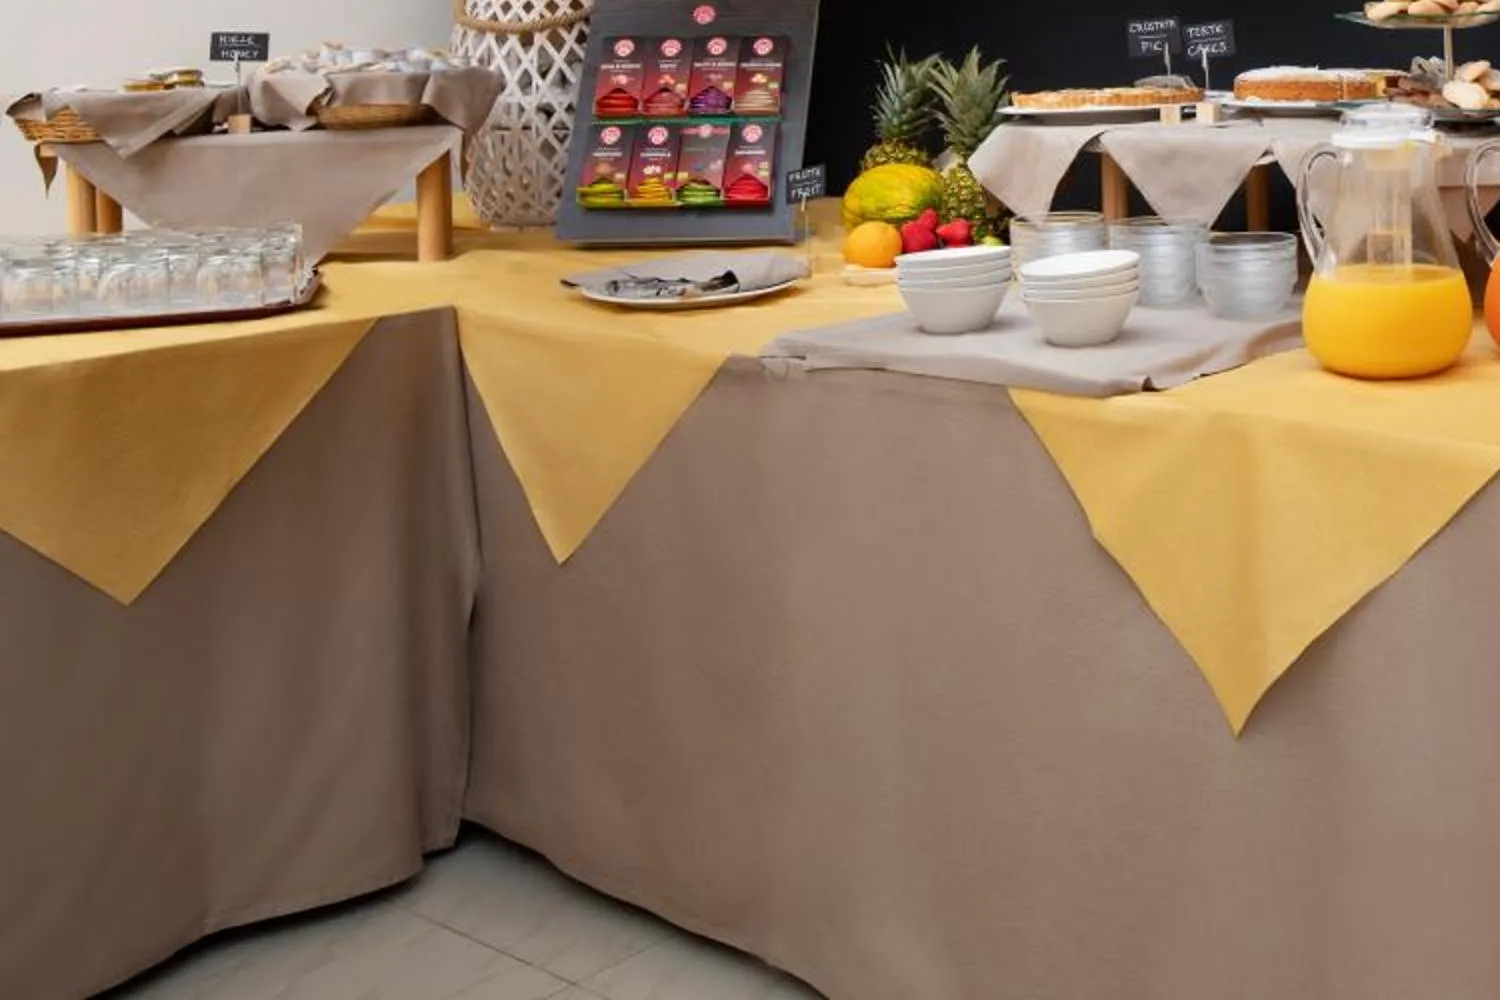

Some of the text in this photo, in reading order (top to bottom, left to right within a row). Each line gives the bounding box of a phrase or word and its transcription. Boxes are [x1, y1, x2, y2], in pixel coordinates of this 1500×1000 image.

[1186, 23, 1223, 39] TORTE
[218, 34, 255, 45] MIELE
[221, 49, 259, 59] HONEY
[1140, 40, 1163, 54] PIE
[1187, 41, 1227, 57] CAKES
